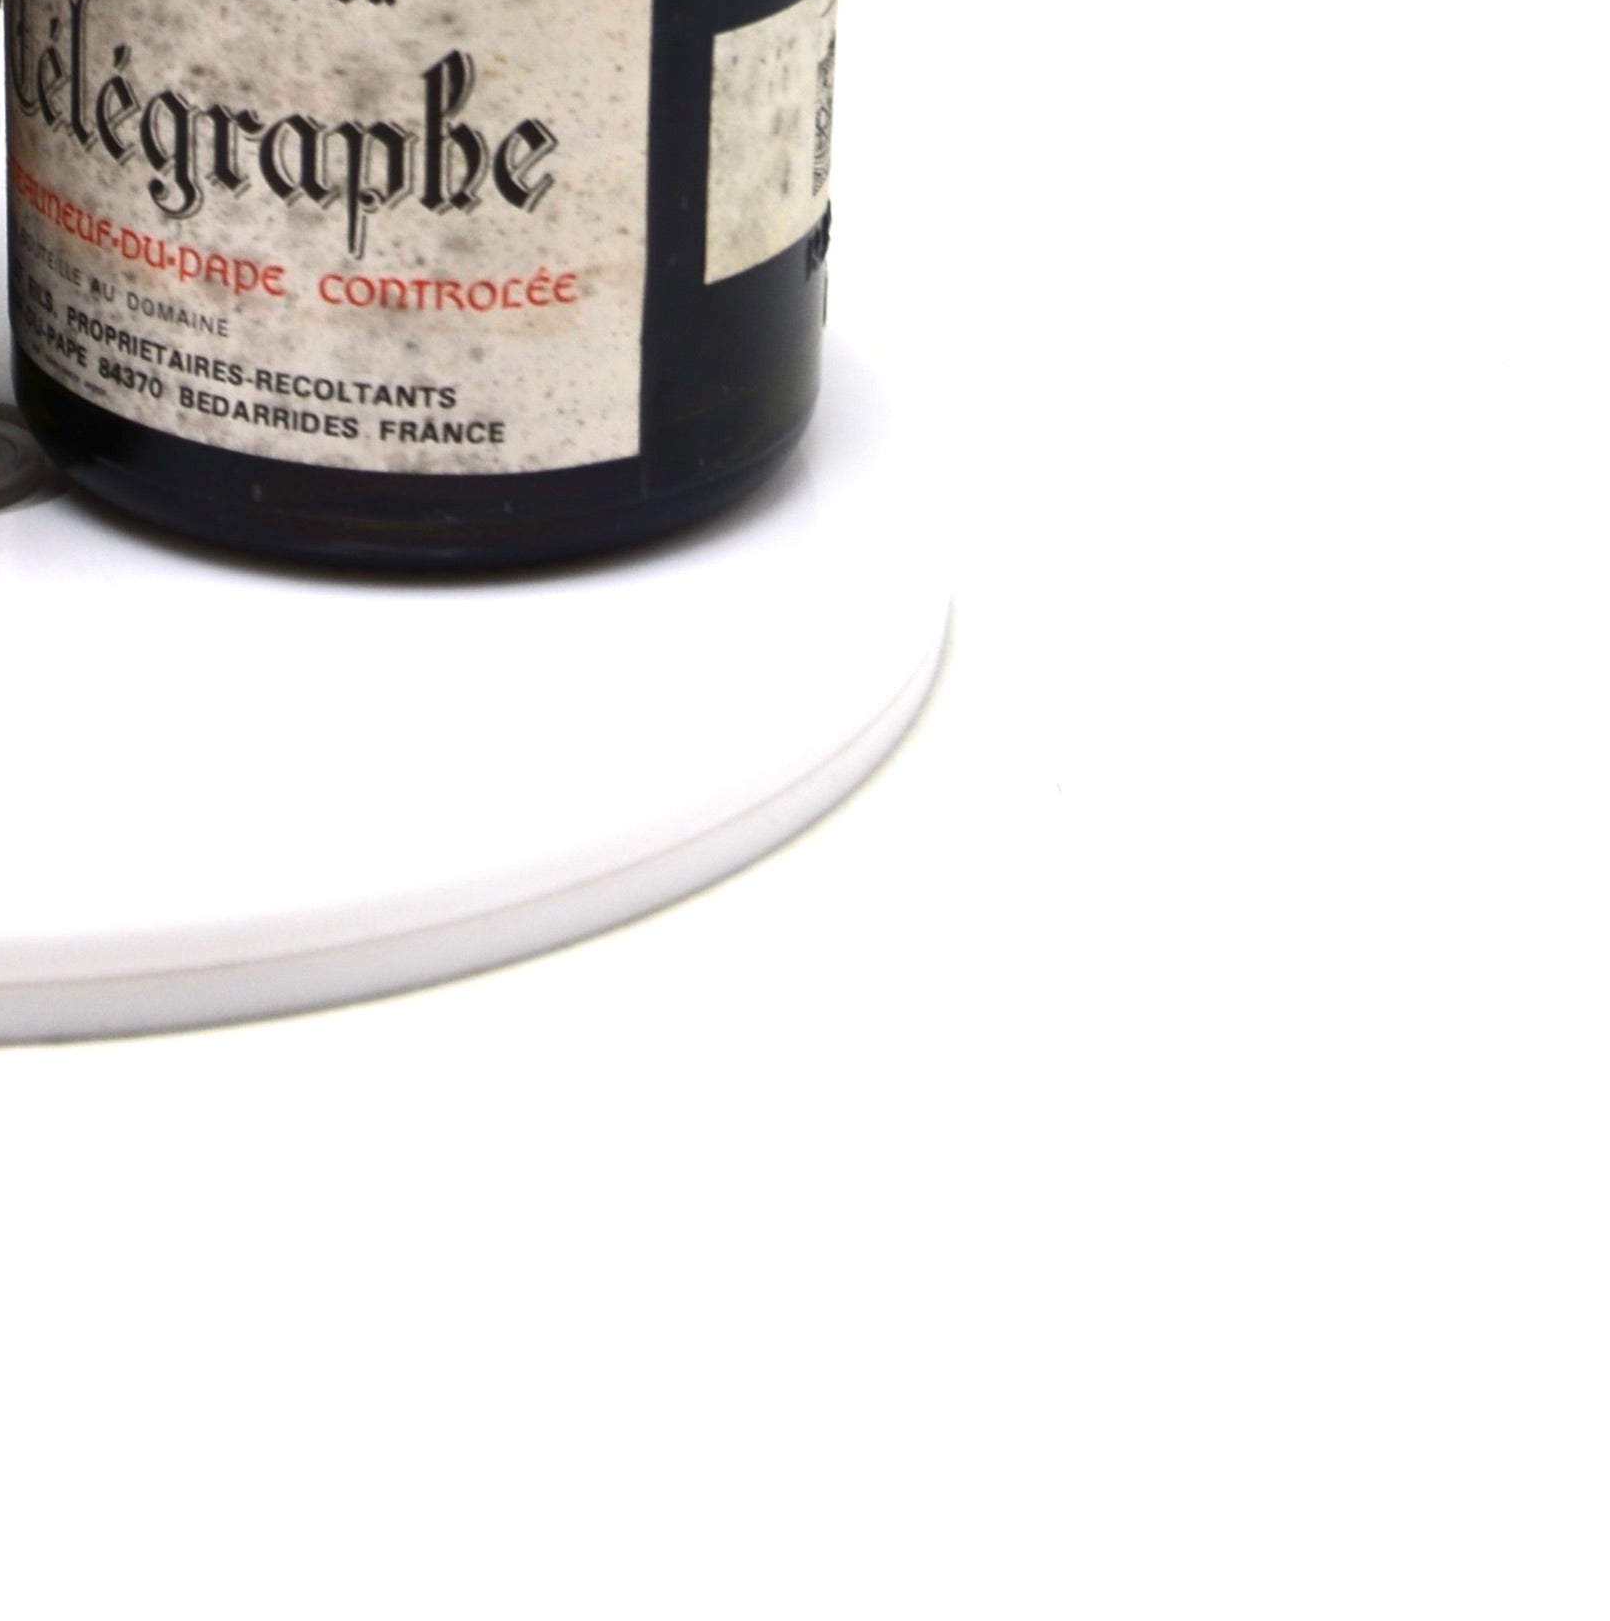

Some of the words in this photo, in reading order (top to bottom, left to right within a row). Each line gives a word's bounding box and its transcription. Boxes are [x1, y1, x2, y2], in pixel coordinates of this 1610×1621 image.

[91, 276, 116, 302] AU
[127, 291, 230, 339] DOMAINE
[67, 305, 458, 411] PROPRIETAIRES-RECOLTANTS
[98, 357, 164, 400] 84370
[179, 385, 360, 441] BEDARRIDES
[379, 419, 505, 444] FRANCE
